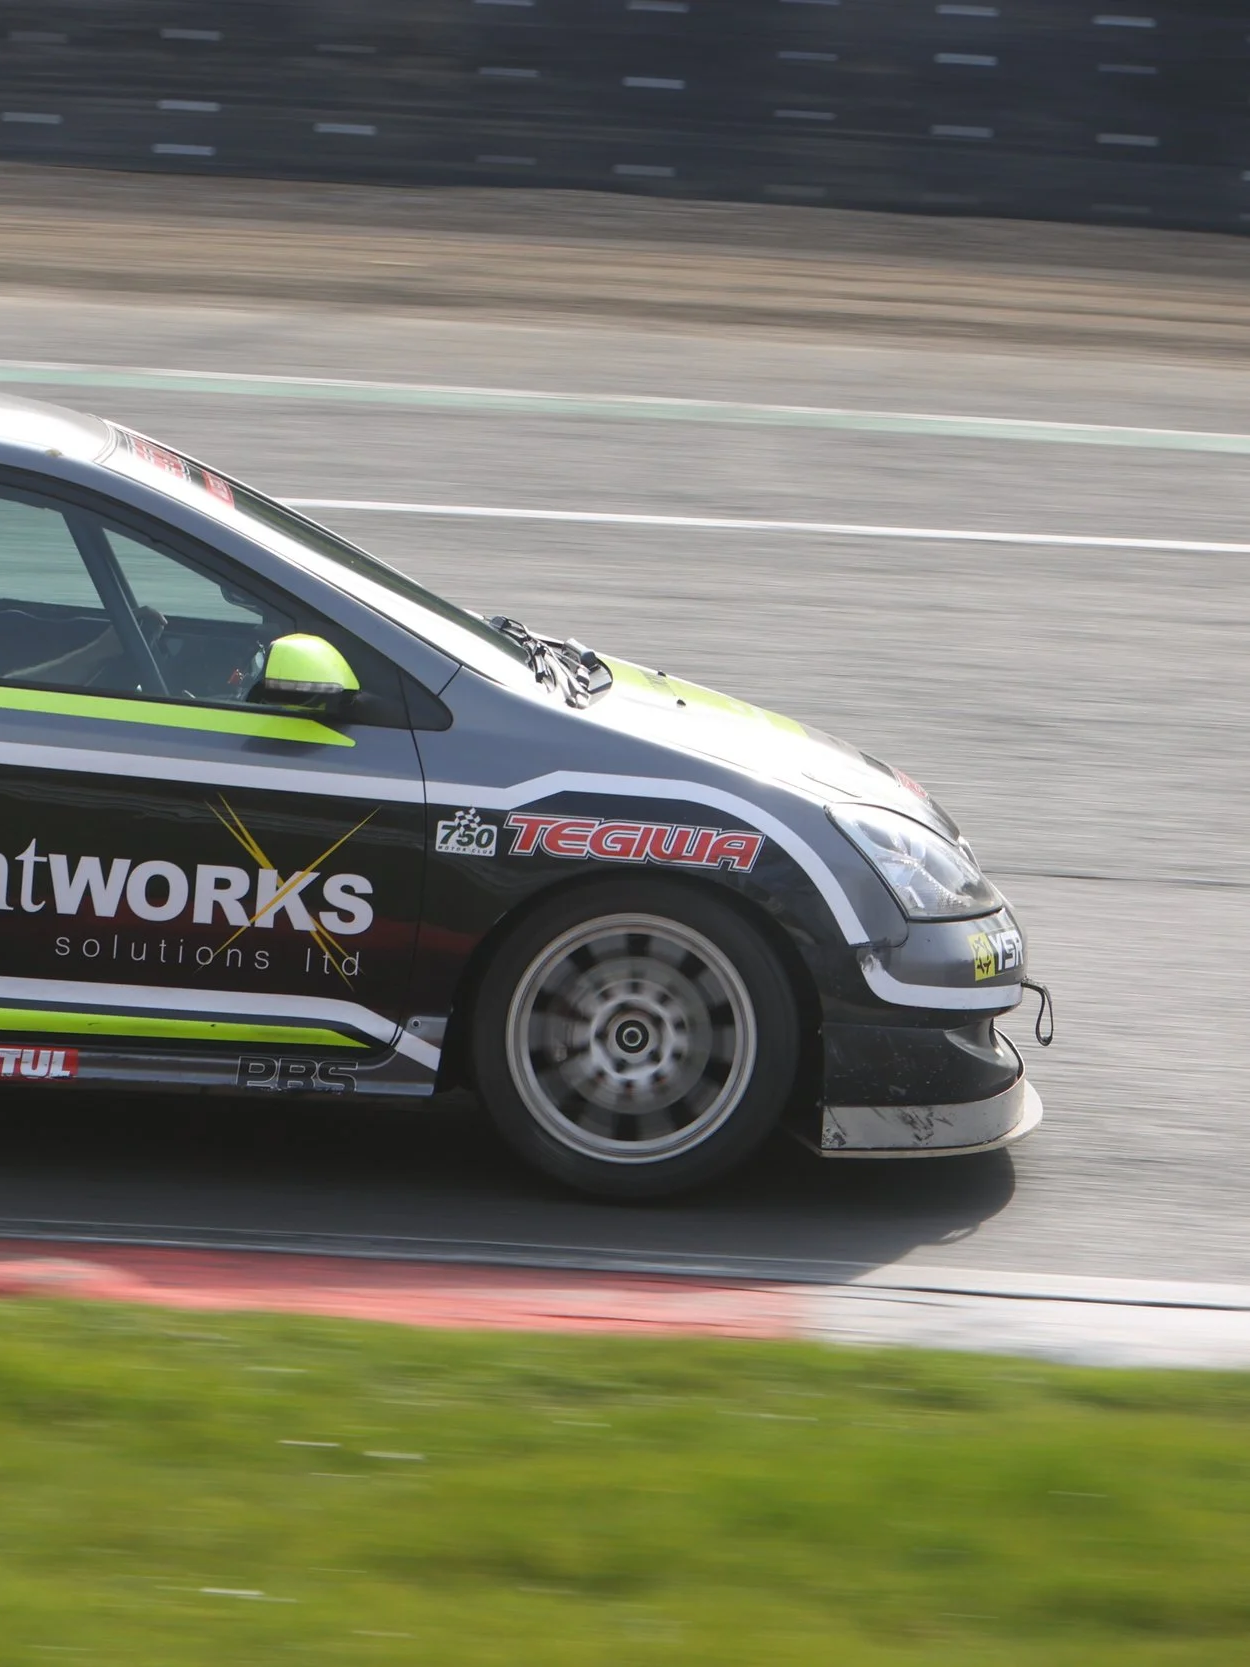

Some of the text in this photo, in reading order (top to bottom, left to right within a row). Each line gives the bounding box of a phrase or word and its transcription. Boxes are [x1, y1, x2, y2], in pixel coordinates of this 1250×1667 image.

[440, 824, 495, 849] 750
[507, 812, 763, 870] TEGIWA
[54, 934, 360, 977] solutions ltd
[988, 929, 1024, 971] YSR
